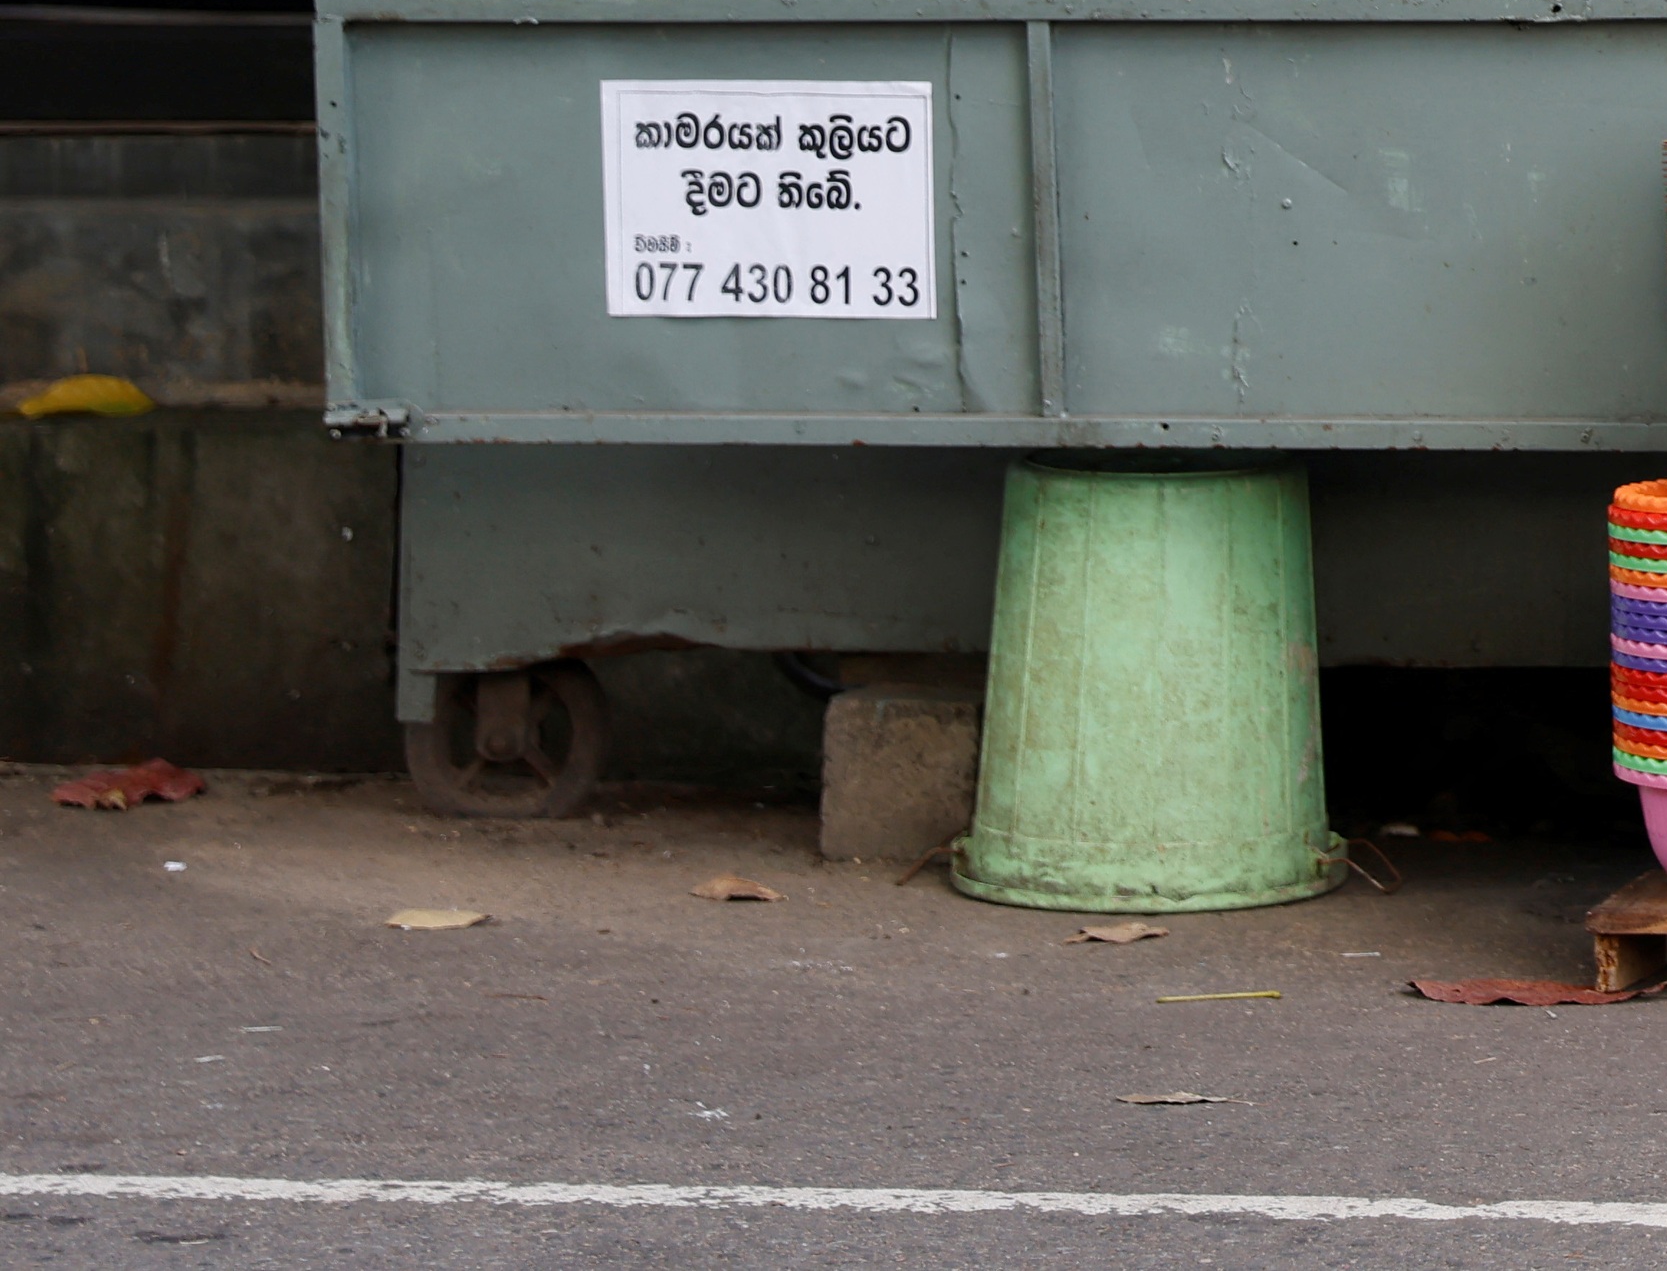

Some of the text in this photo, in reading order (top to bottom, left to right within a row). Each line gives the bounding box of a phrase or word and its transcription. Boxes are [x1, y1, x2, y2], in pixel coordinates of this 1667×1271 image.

[635, 263, 919, 307] 077 430 81 33
